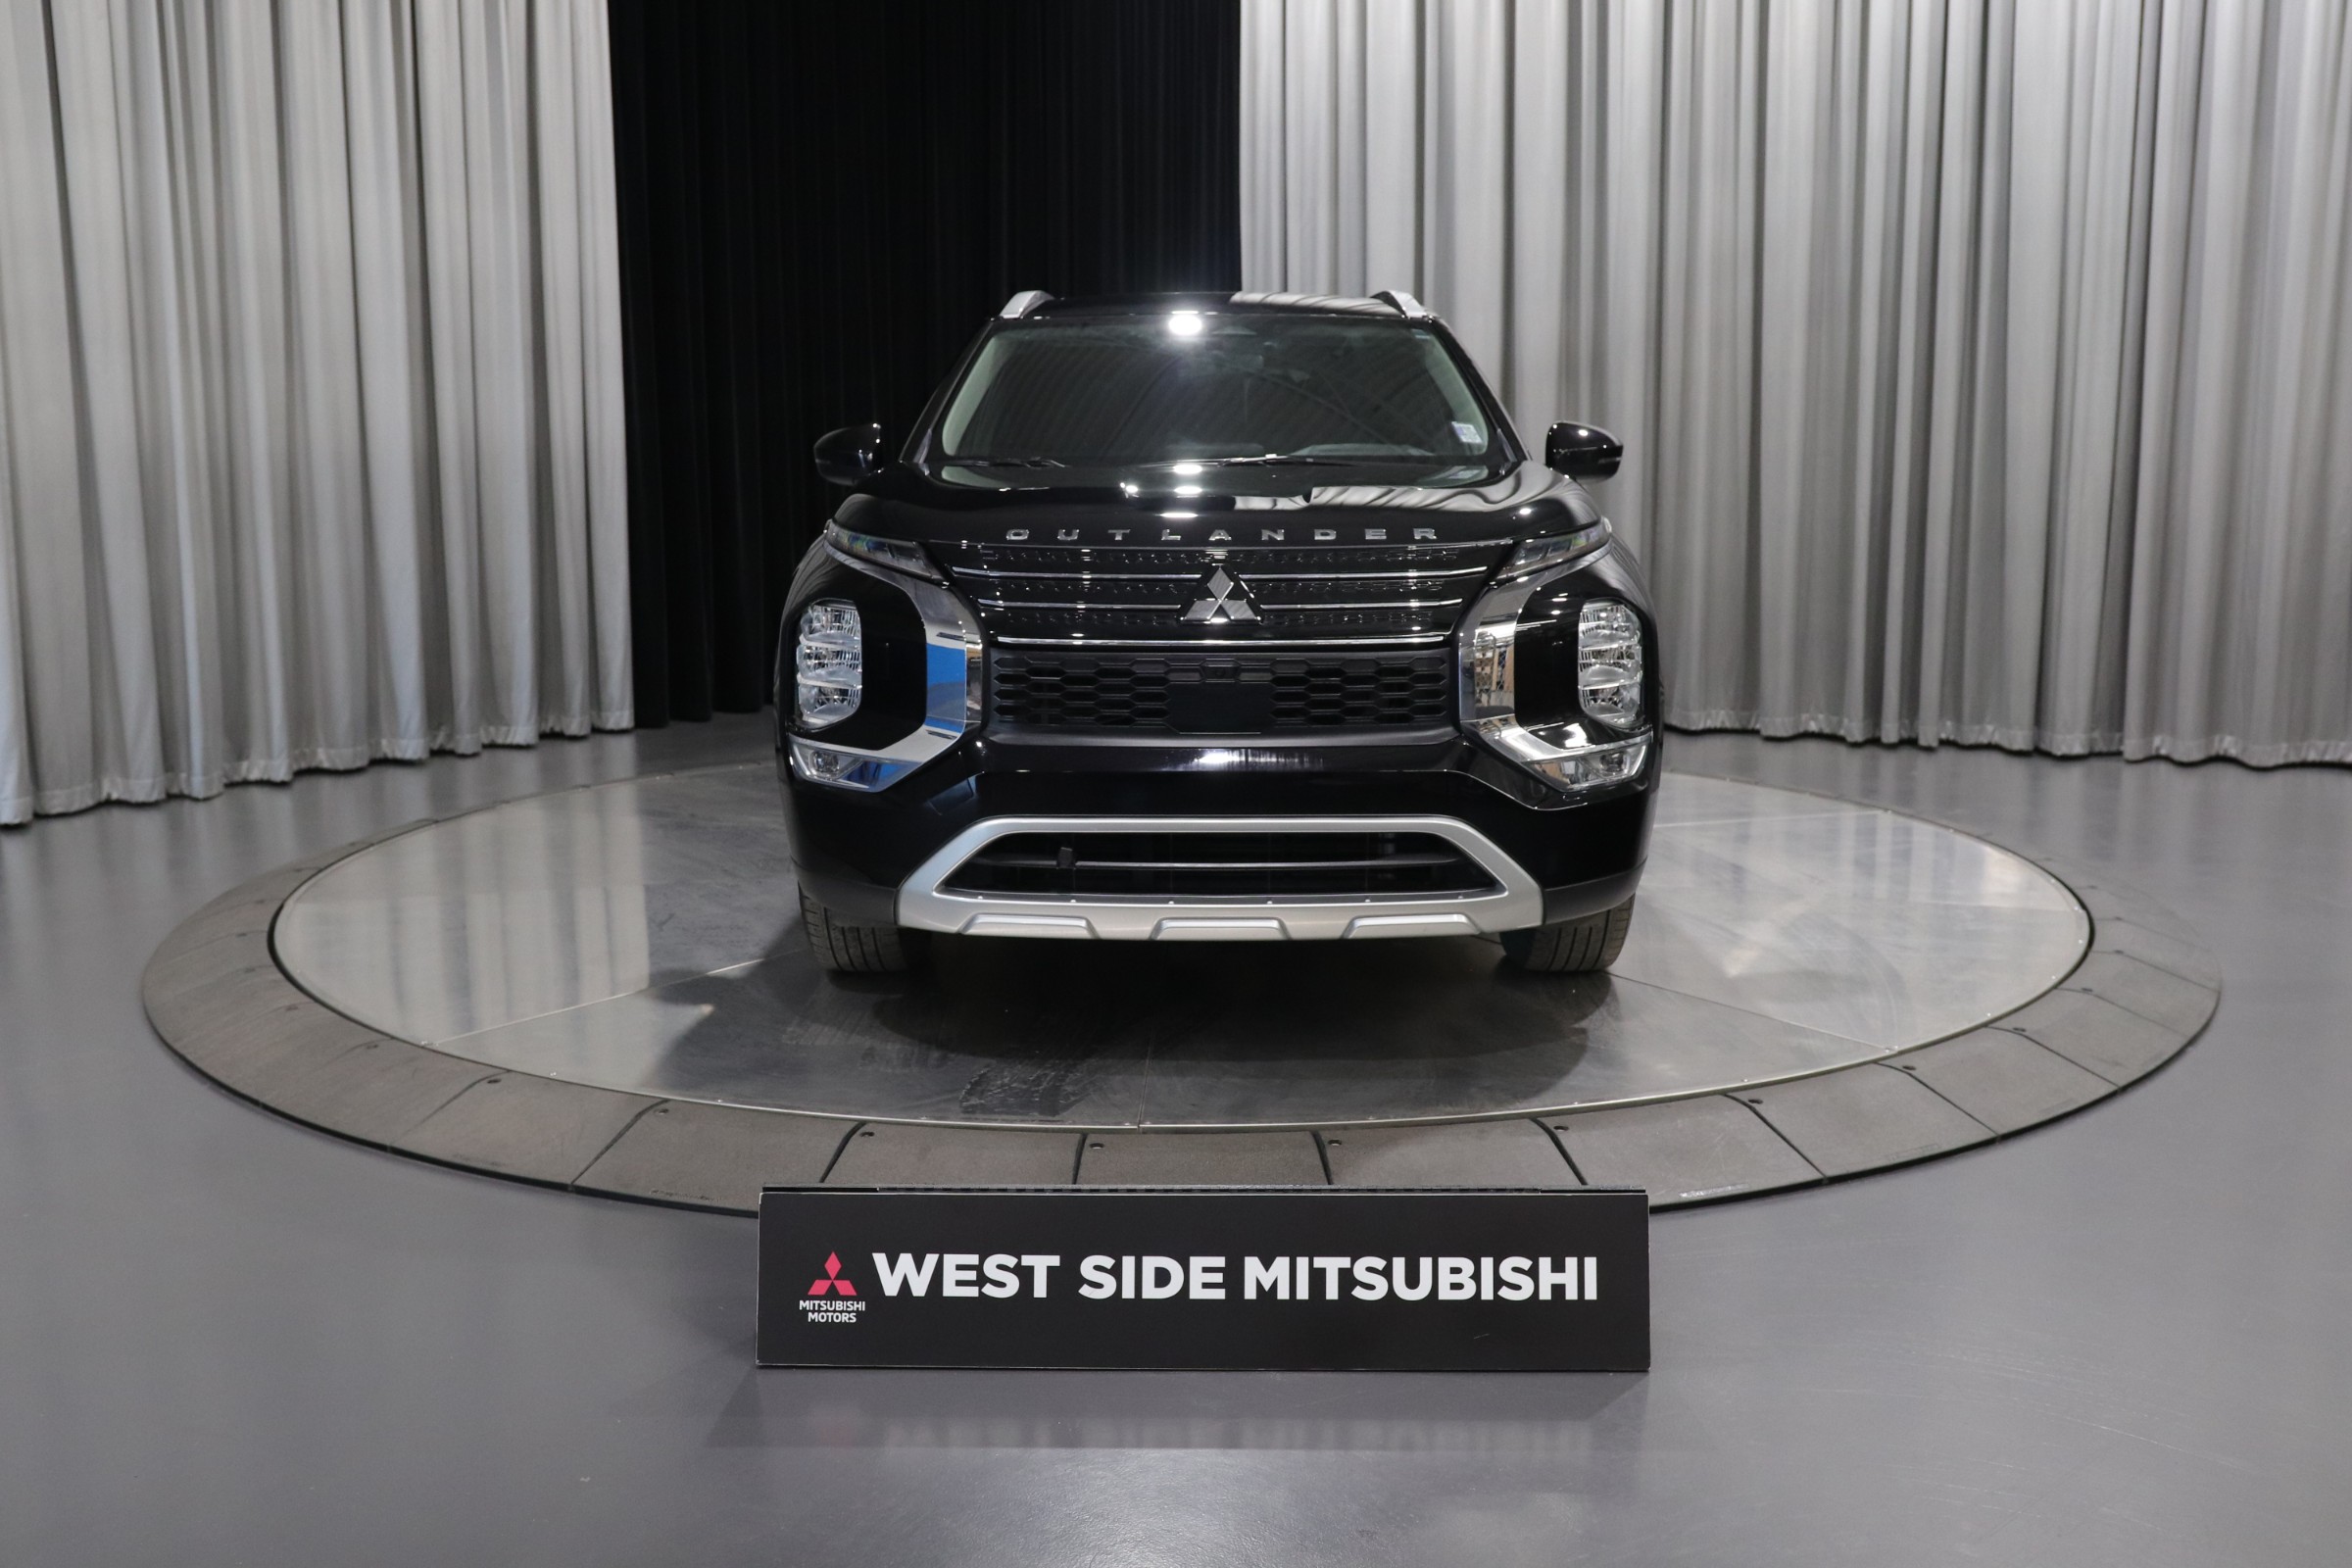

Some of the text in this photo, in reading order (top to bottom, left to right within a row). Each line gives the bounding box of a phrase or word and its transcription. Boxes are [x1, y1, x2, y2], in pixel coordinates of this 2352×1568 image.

[1005, 527, 1438, 541] OUTLANDER
[871, 1251, 1597, 1301] WEST SIDE MITSUBISHI
[799, 1299, 866, 1311] MITSUBISHI
[808, 1311, 858, 1323] MOTORS
